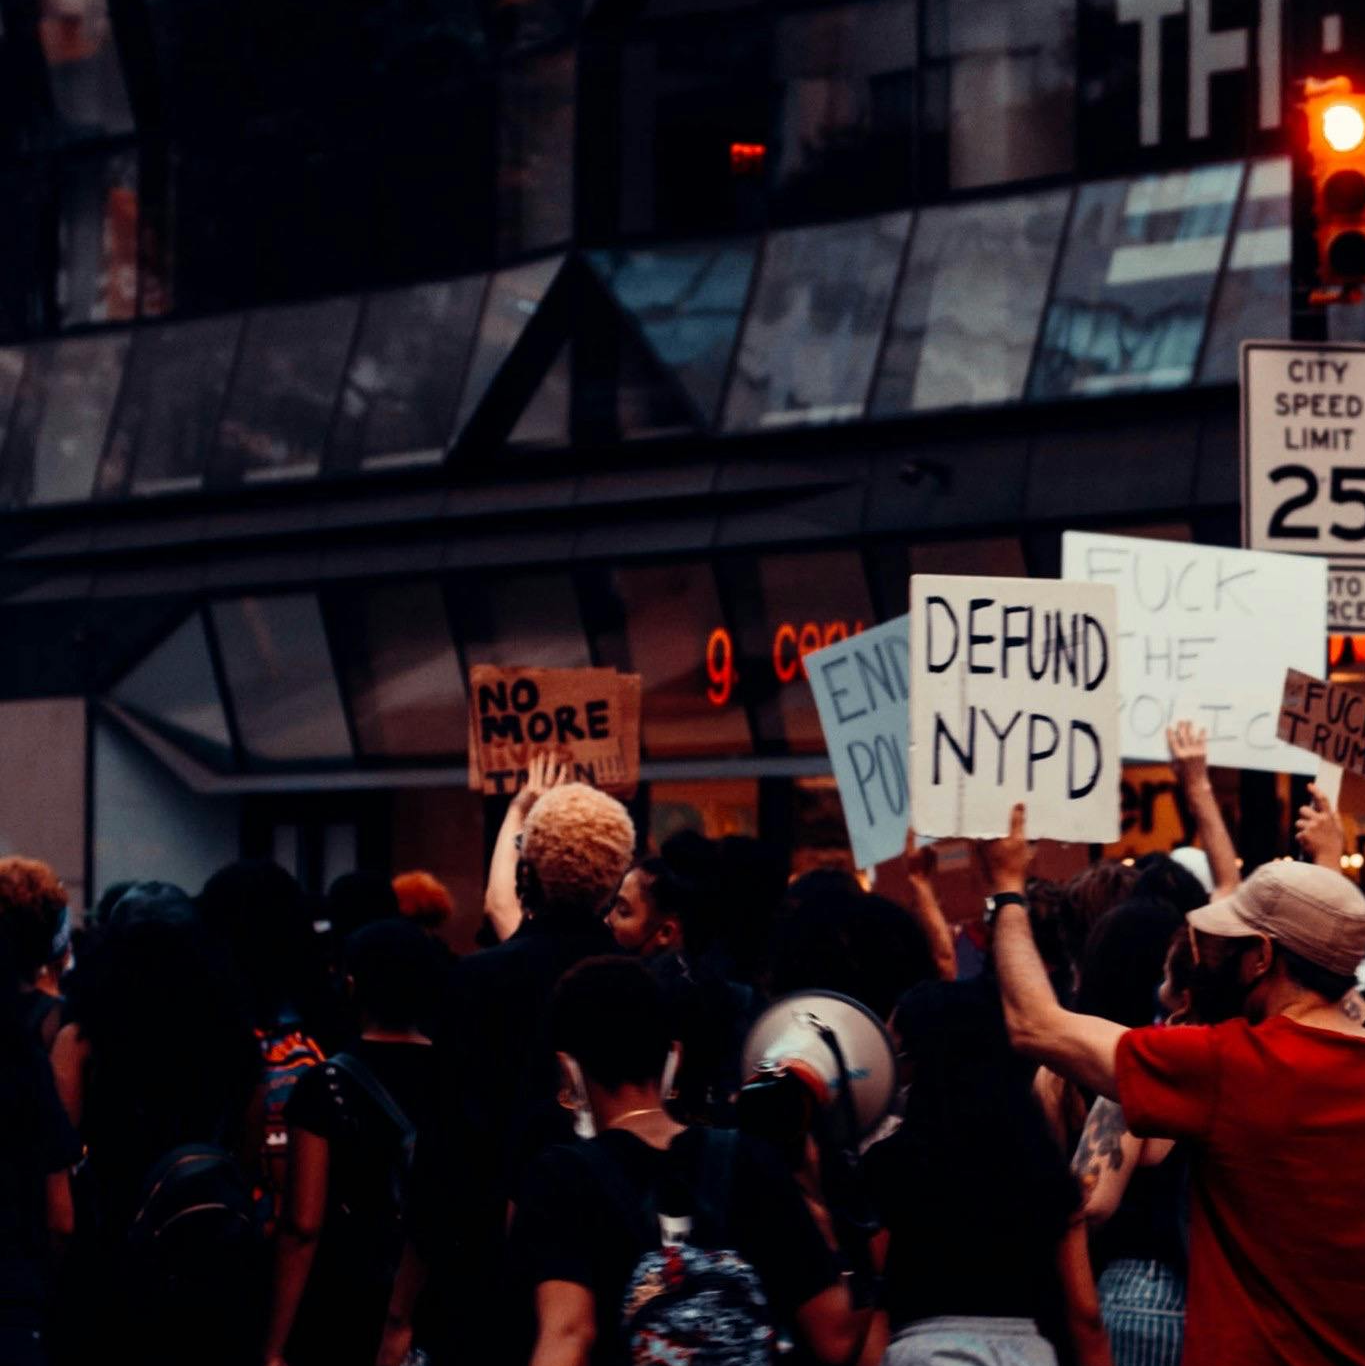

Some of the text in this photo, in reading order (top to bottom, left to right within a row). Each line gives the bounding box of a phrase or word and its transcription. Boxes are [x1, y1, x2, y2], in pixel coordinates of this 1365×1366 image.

[1287, 359, 1349, 383] CITY
[1274, 392, 1364, 418] SPEED
[1284, 426, 1355, 451] LIMIT
[1086, 547, 1257, 616] FUCK
[1327, 575, 1362, 598] TO
[926, 595, 1109, 692] DEFUND
[1119, 631, 1217, 682] HE
[478, 677, 540, 715] NO
[481, 699, 609, 744] MORE
[932, 705, 1103, 801] NYPD
